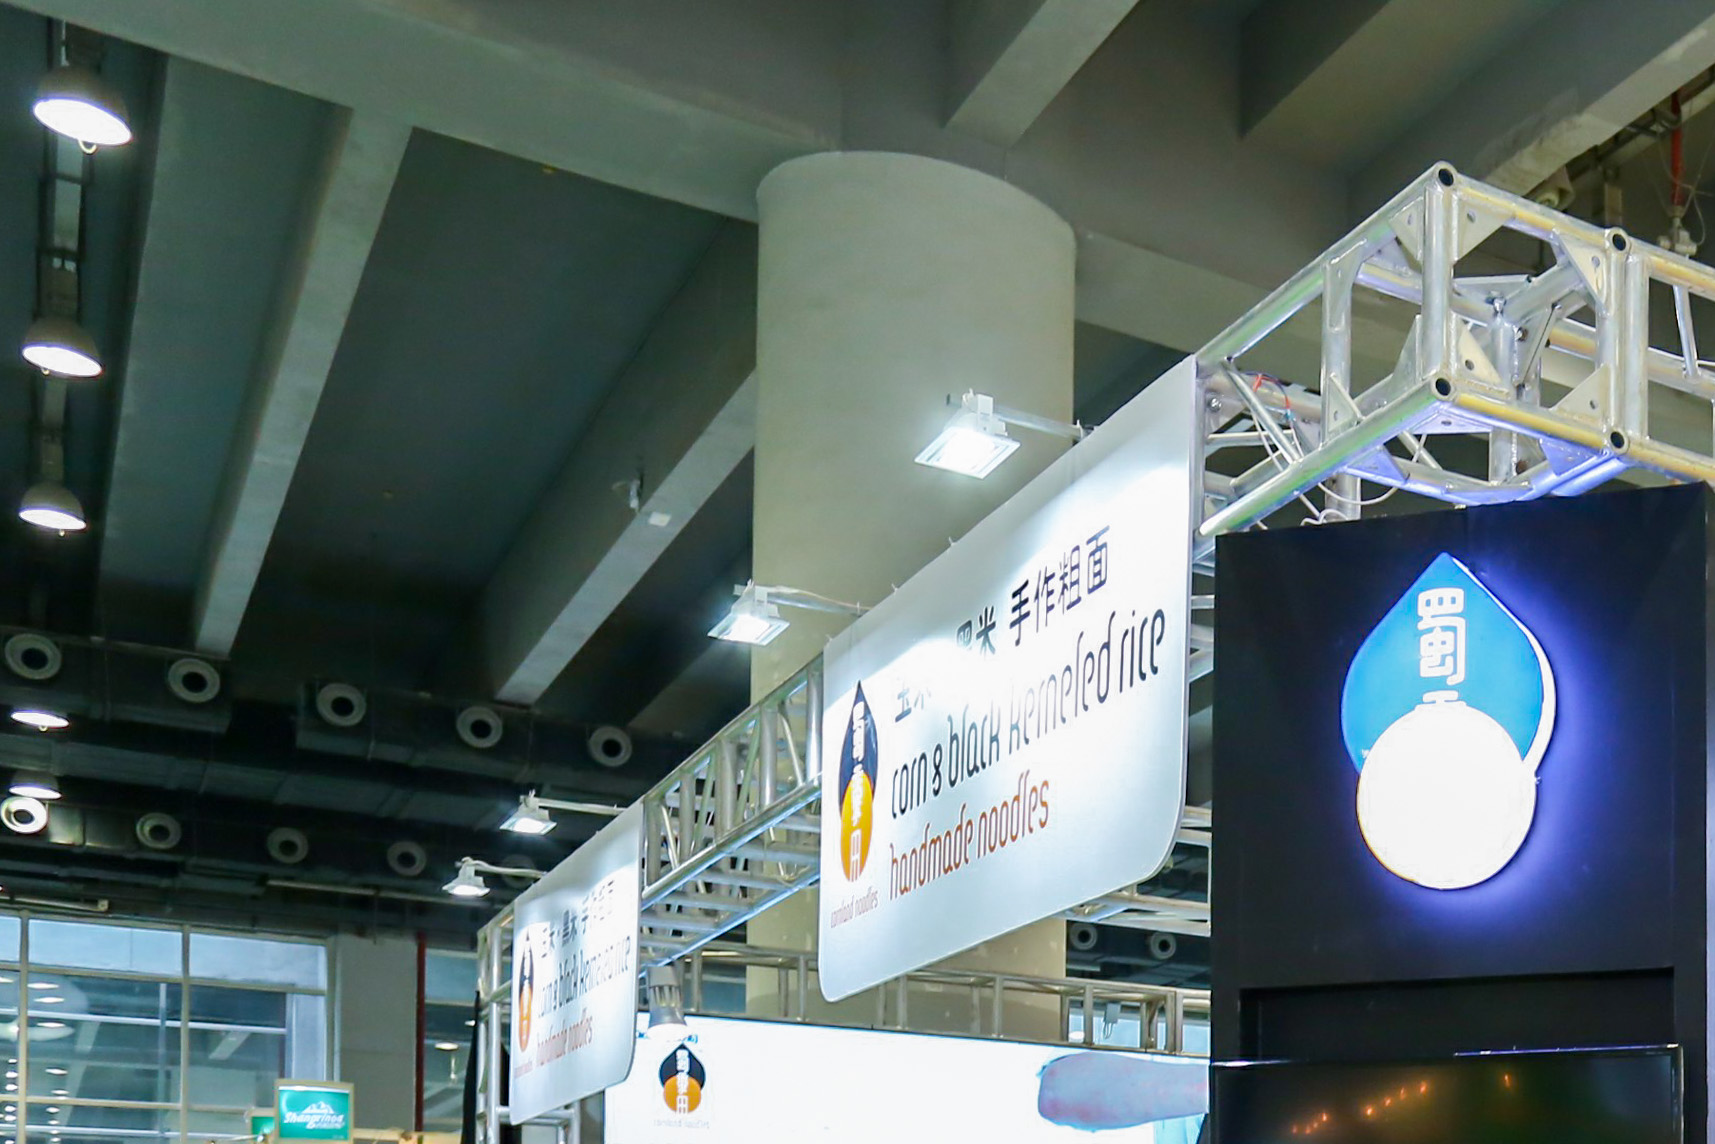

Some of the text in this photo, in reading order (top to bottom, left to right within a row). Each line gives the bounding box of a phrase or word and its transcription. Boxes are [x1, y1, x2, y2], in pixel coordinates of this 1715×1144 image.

[1009, 525, 1111, 646] 手作粗面
[892, 752, 928, 819] corn
[947, 700, 1001, 788] black
[1009, 611, 1113, 755] kerneled
[1119, 608, 1166, 694] rice
[889, 769, 1050, 901] handmade noodles
